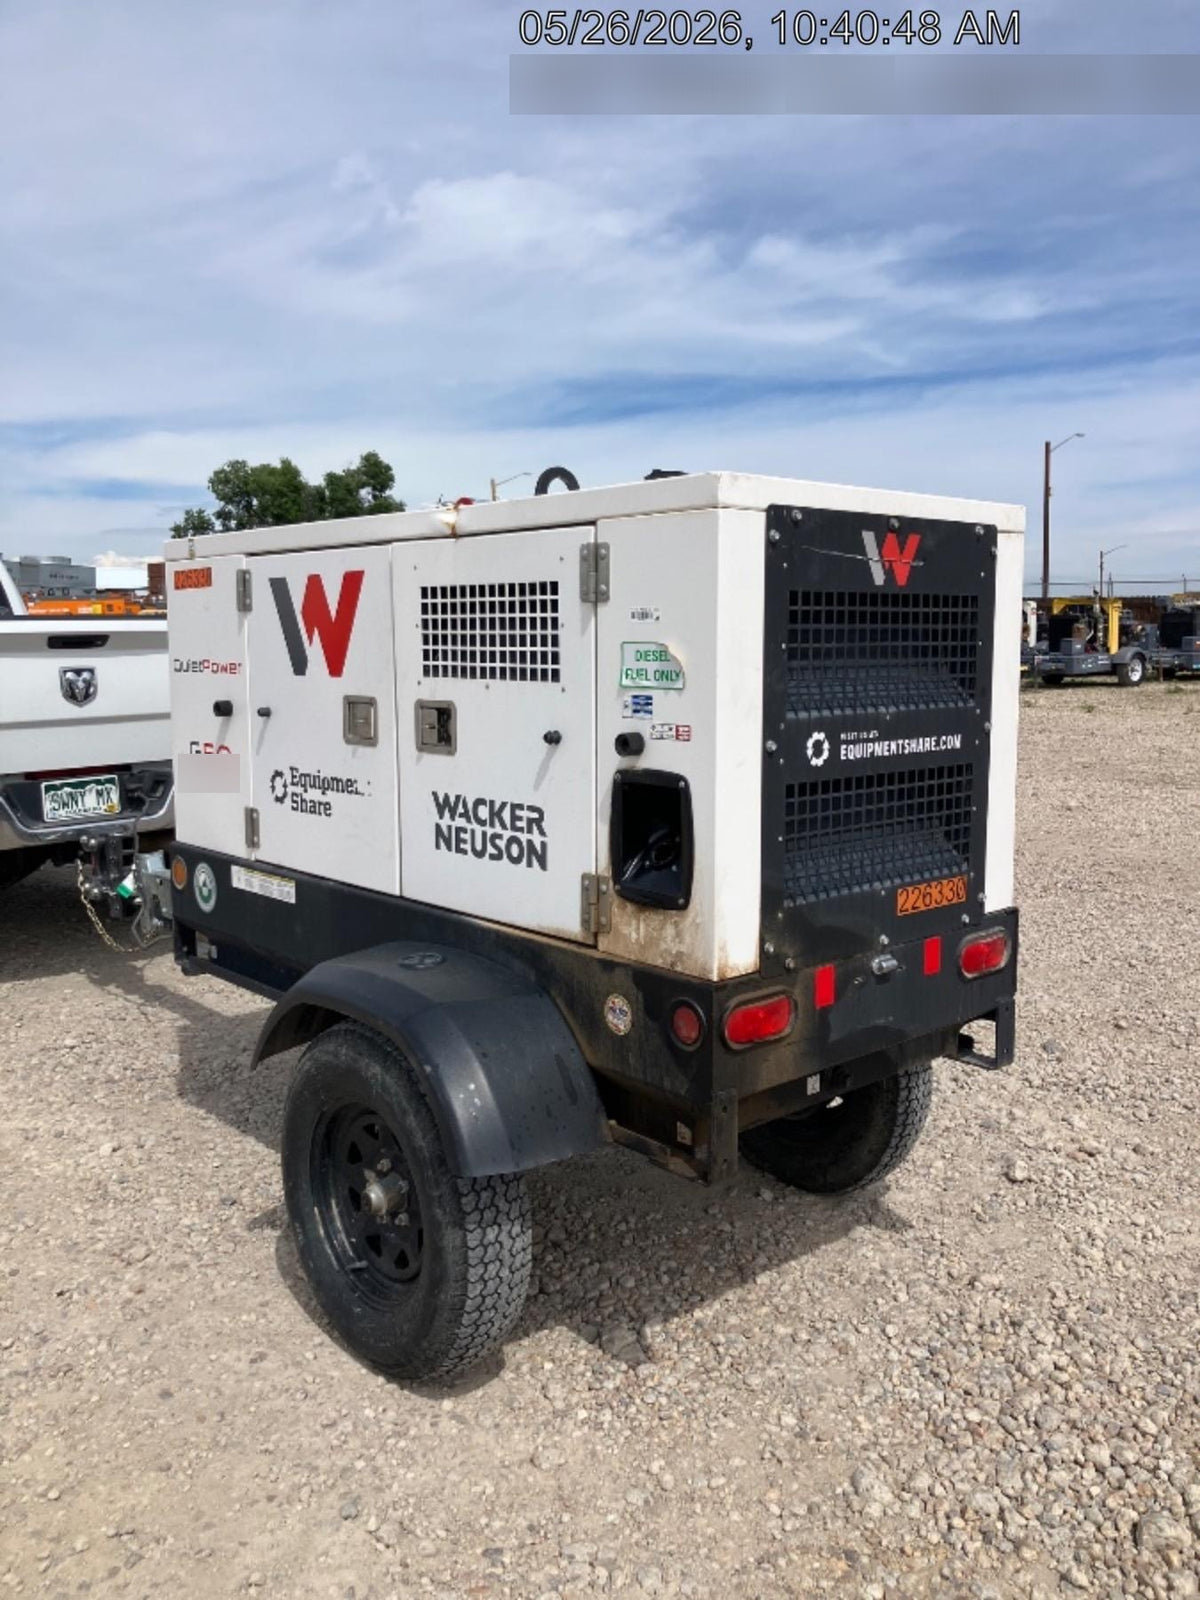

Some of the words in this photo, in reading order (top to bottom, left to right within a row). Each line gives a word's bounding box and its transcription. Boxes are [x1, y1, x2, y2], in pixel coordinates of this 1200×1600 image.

[635, 650, 671, 663] DIESEL
[625, 668, 650, 682] FUEL
[654, 669, 682, 683] ONLY
[840, 734, 962, 760] EQUIPMENTSHARE.COM
[289, 766, 371, 796] Equipme
[291, 791, 332, 817] Share
[432, 791, 547, 837] WACKER
[435, 823, 548, 871] NEUSON
[899, 877, 966, 912] 226330
